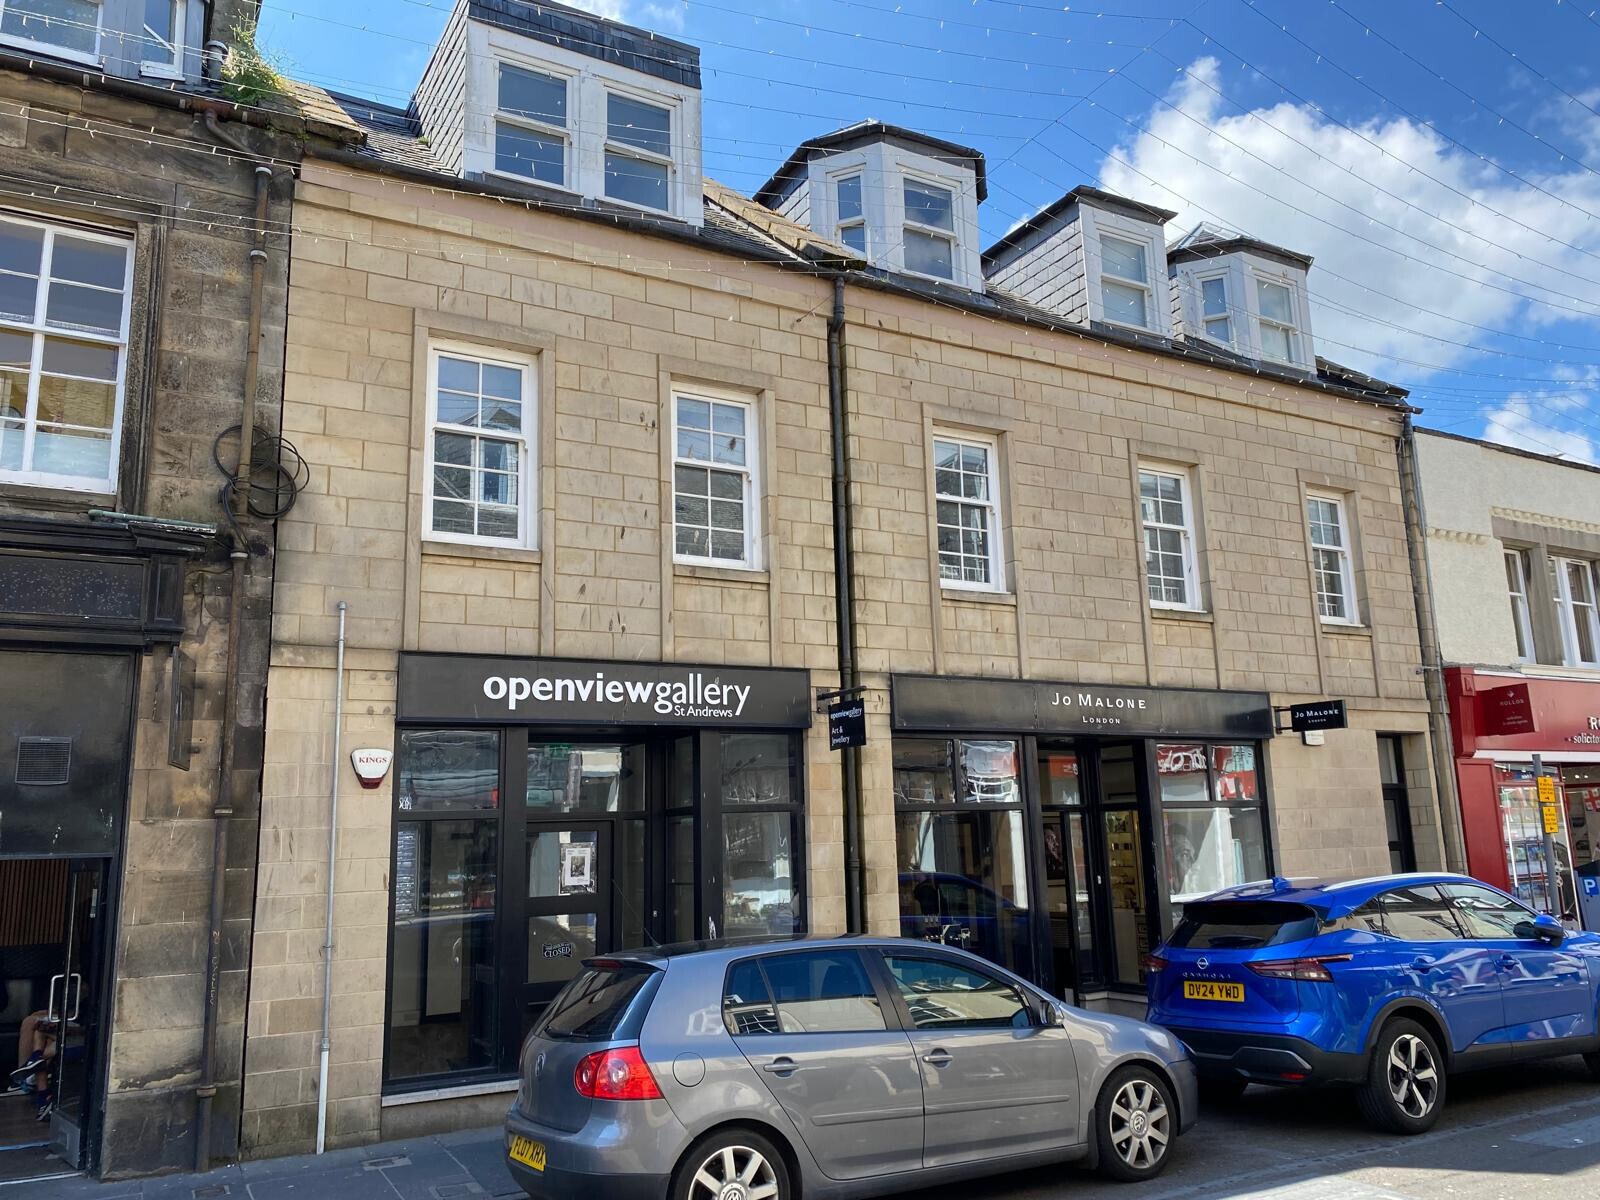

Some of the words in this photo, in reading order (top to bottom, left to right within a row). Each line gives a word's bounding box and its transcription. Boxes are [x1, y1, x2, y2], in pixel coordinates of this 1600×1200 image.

[483, 673, 750, 715] openviewgallery
[1078, 693, 1146, 709] MALONE
[674, 705, 686, 716] St
[686, 705, 733, 718] Andrews
[1306, 709, 1339, 717] MALONE
[1082, 716, 1121, 724] LONDON
[1590, 716, 1600, 730] R
[1584, 879, 1596, 894] P
[544, 946, 571, 958] CLOSED
[1188, 983, 1215, 997] DV24
[1218, 984, 1239, 998] YWD
[514, 1136, 531, 1158] FL07
